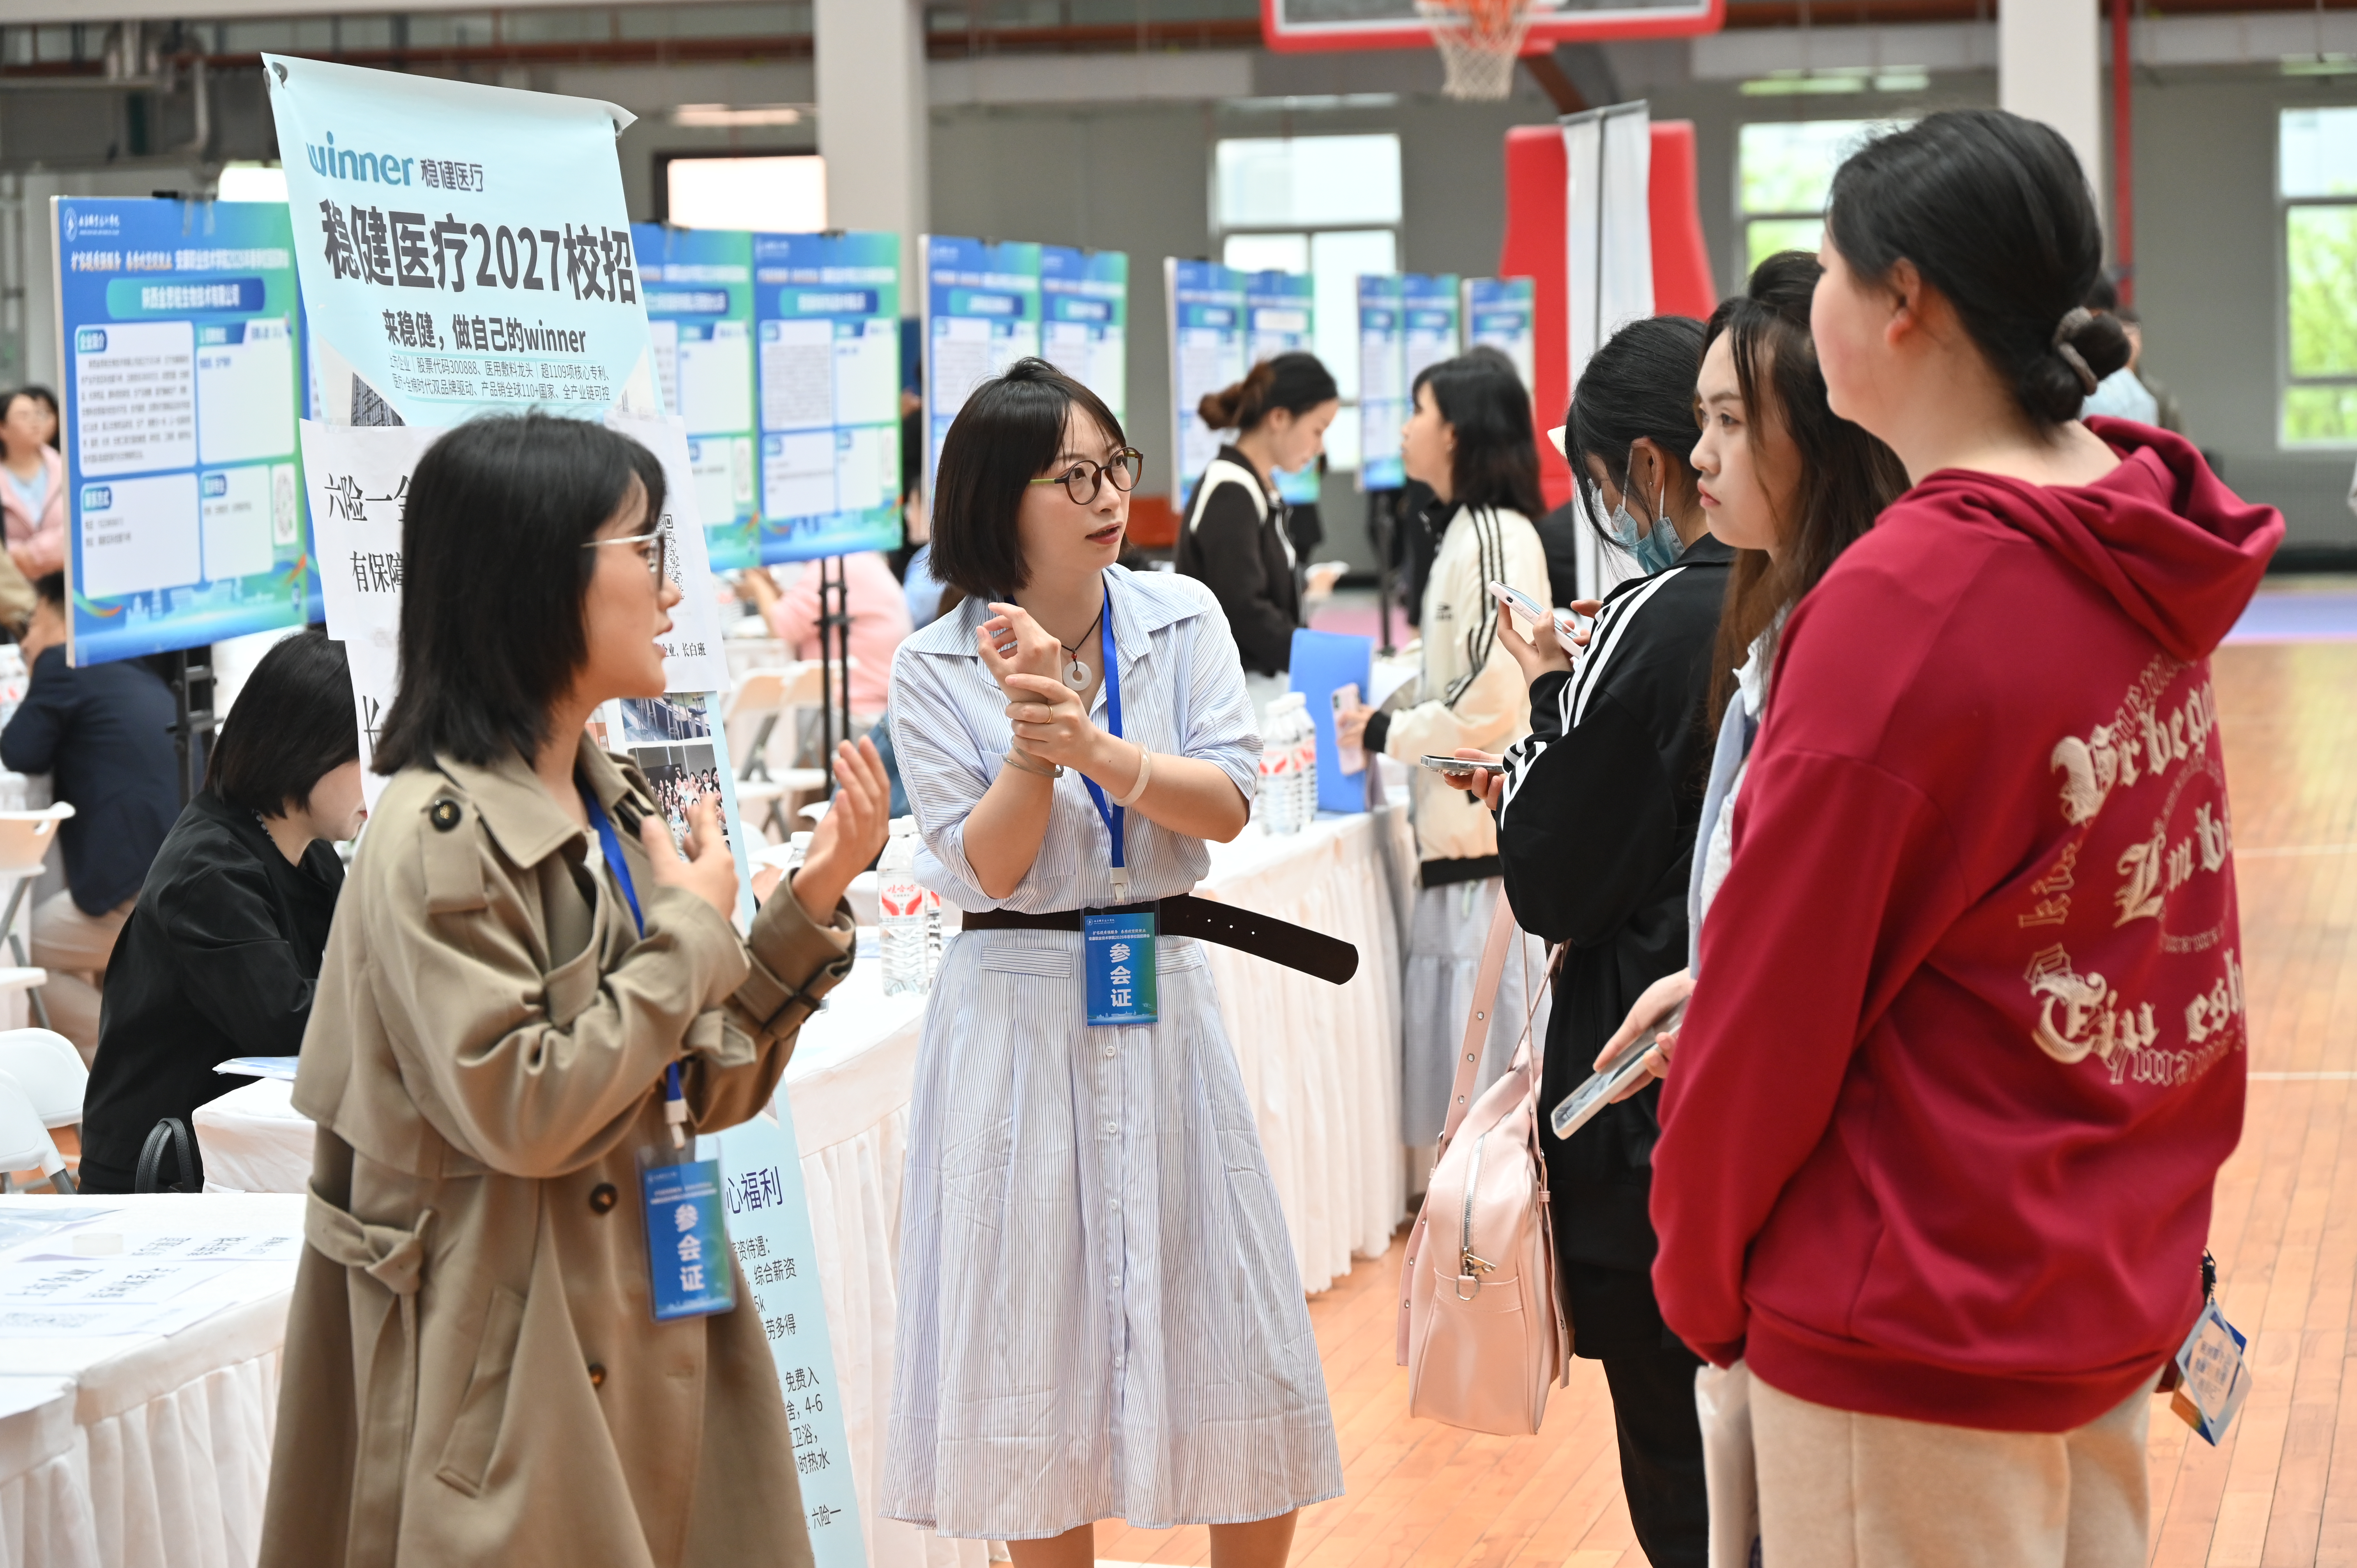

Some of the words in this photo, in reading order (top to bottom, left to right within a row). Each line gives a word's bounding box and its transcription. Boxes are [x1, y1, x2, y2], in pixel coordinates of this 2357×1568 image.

[306, 131, 414, 186] winner
[420, 158, 483, 192] 稳健医疗
[318, 198, 637, 305] 稳健医疗2027校招
[382, 308, 586, 353] 来稳健，做自己的winner
[350, 550, 403, 593] 有保障
[656, 642, 707, 658] 企业，长白班
[1109, 943, 1133, 1007] 参会证
[726, 1165, 783, 1214] 心福利
[674, 1204, 705, 1292] 参会证
[742, 1257, 797, 1288] ，综合薪资
[762, 1313, 796, 1341] 劳多得
[783, 1393, 823, 1422] 舍，4-6
